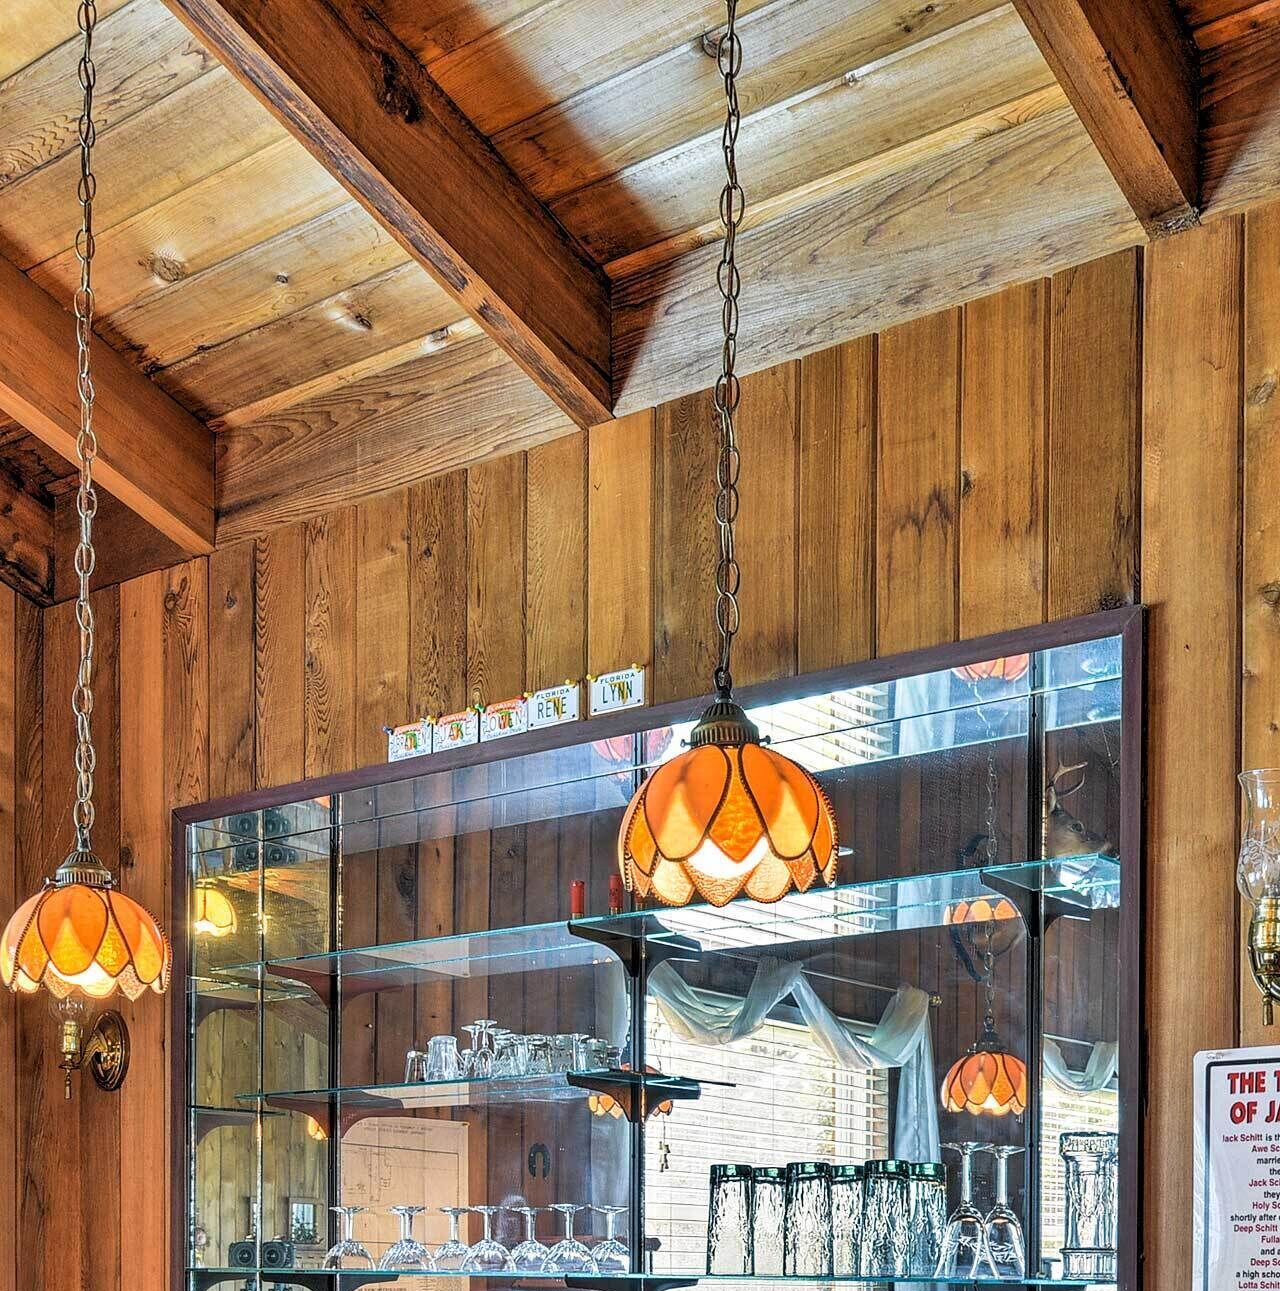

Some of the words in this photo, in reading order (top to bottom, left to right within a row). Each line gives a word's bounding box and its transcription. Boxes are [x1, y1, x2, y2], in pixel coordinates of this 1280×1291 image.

[600, 672, 635, 684] FLORIDA
[536, 688, 570, 700] FLORIDA
[602, 681, 632, 704] LYNN
[538, 697, 566, 719] RENE
[1227, 1072, 1266, 1094] THE
[1230, 1101, 1258, 1124] OF
[1239, 1133, 1262, 1141] Schitt
[1265, 1133, 1272, 1141] is
[1269, 1166, 1280, 1175] the
[1263, 1191, 1280, 1200] they
[1251, 1201, 1270, 1211] Holy
[1230, 1213, 1257, 1223] shortly
[1258, 1213, 1276, 1221] after
[1233, 1224, 1253, 1234] Deep
[1261, 1235, 1280, 1243] Fulla
[1250, 1258, 1271, 1268] Deep
[1242, 1269, 1259, 1279] high
